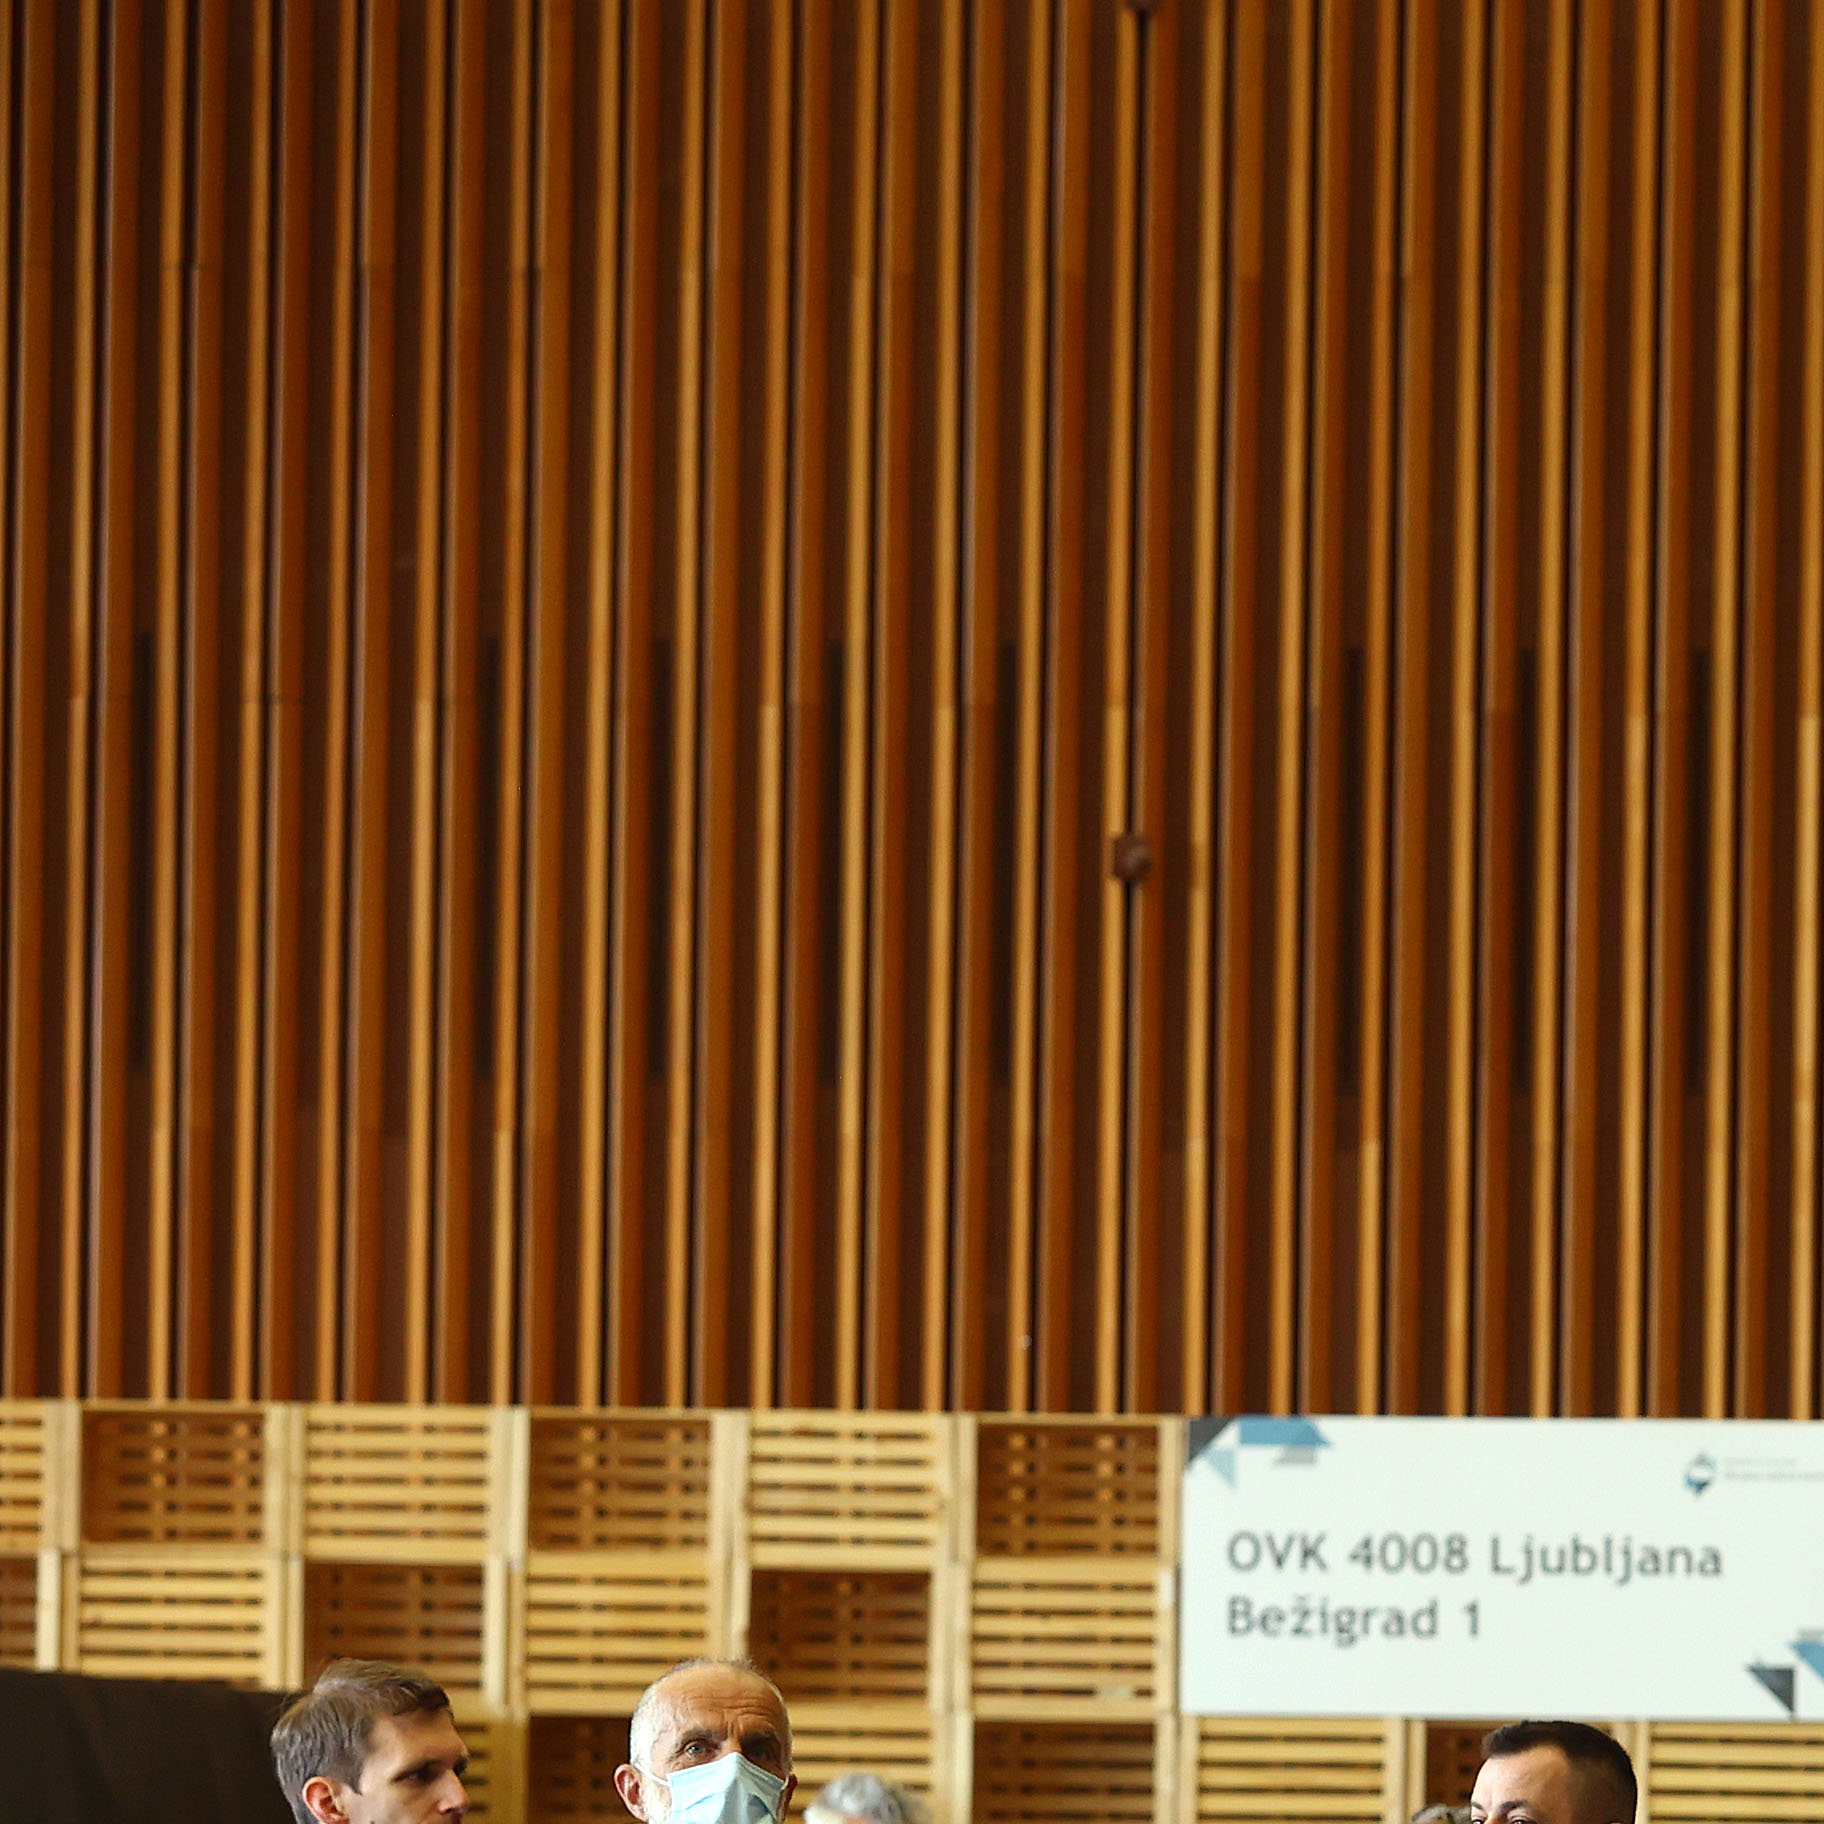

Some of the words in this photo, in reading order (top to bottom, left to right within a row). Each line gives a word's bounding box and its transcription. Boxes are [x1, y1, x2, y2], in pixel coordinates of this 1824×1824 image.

[1227, 1531, 1328, 1572] OVK
[1348, 1533, 1470, 1574] 4008
[1490, 1534, 1722, 1585] Ljubljana
[1227, 1595, 1439, 1648] Bežigrad
[1463, 1600, 1482, 1637] 1
